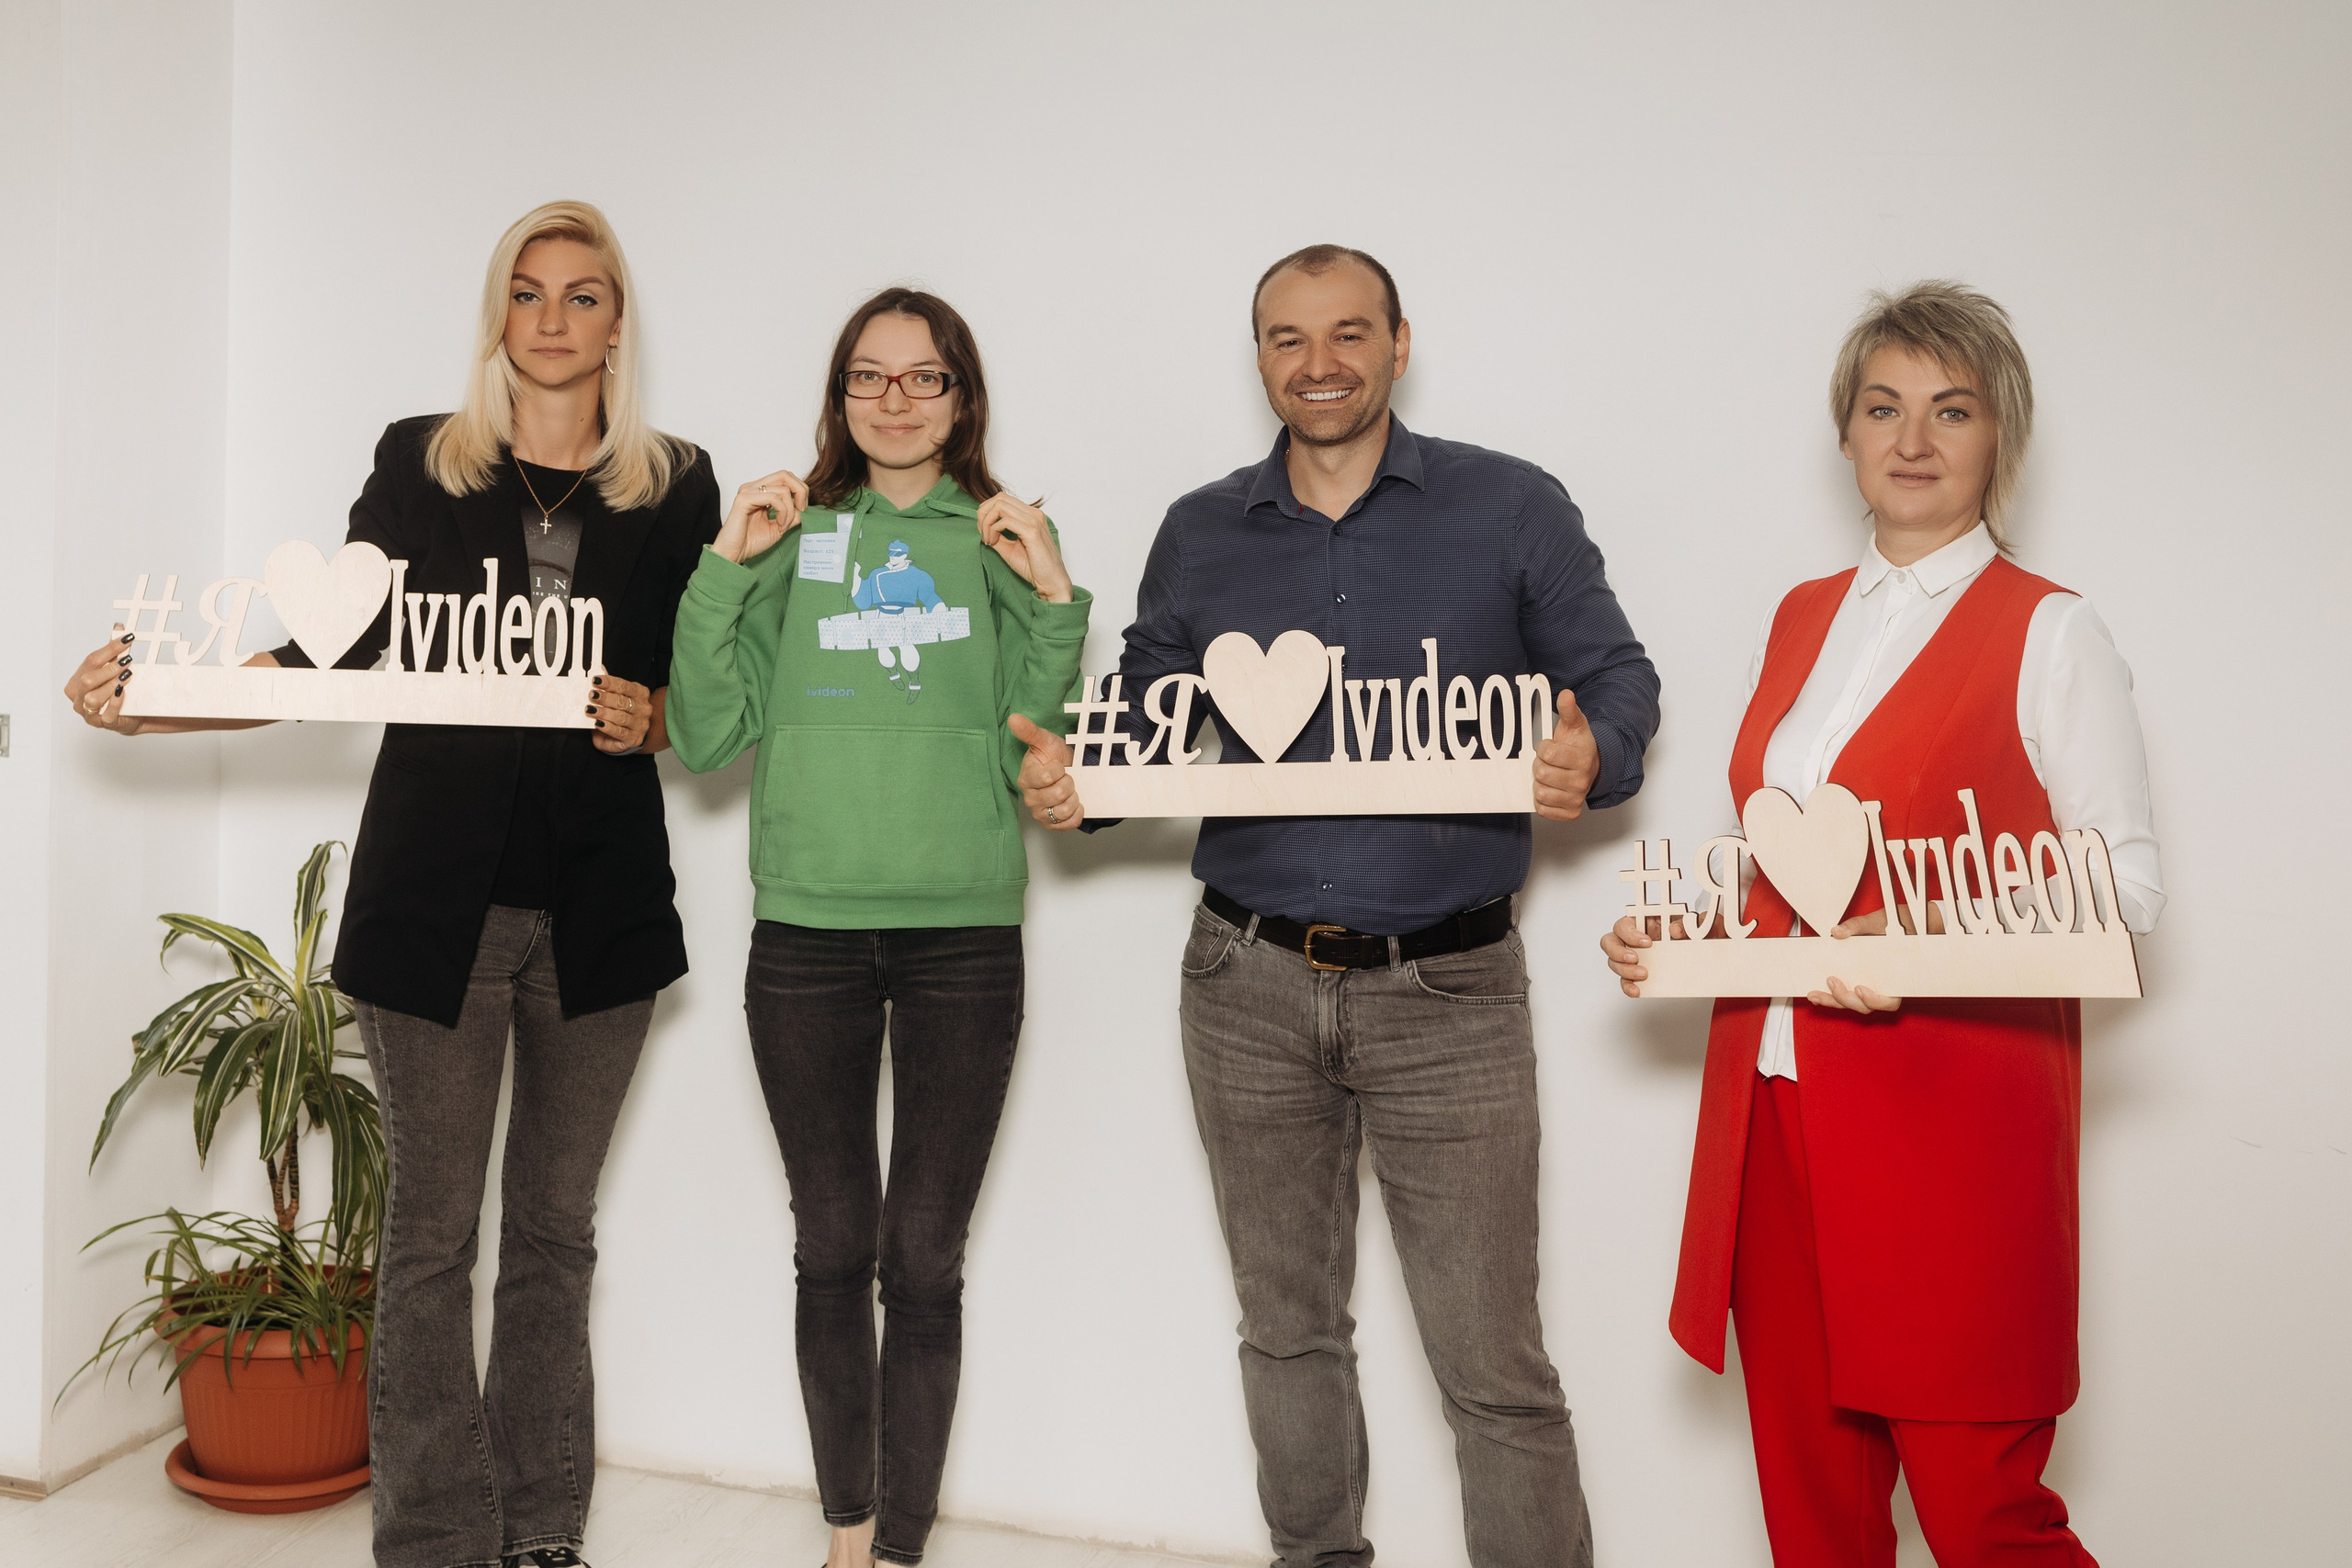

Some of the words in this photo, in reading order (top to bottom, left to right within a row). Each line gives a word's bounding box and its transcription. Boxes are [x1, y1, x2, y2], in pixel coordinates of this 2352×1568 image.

[386, 558, 605, 677] Ivideon
[1327, 638, 1553, 762] Ivideon
[1863, 788, 2128, 936] Ivideon
